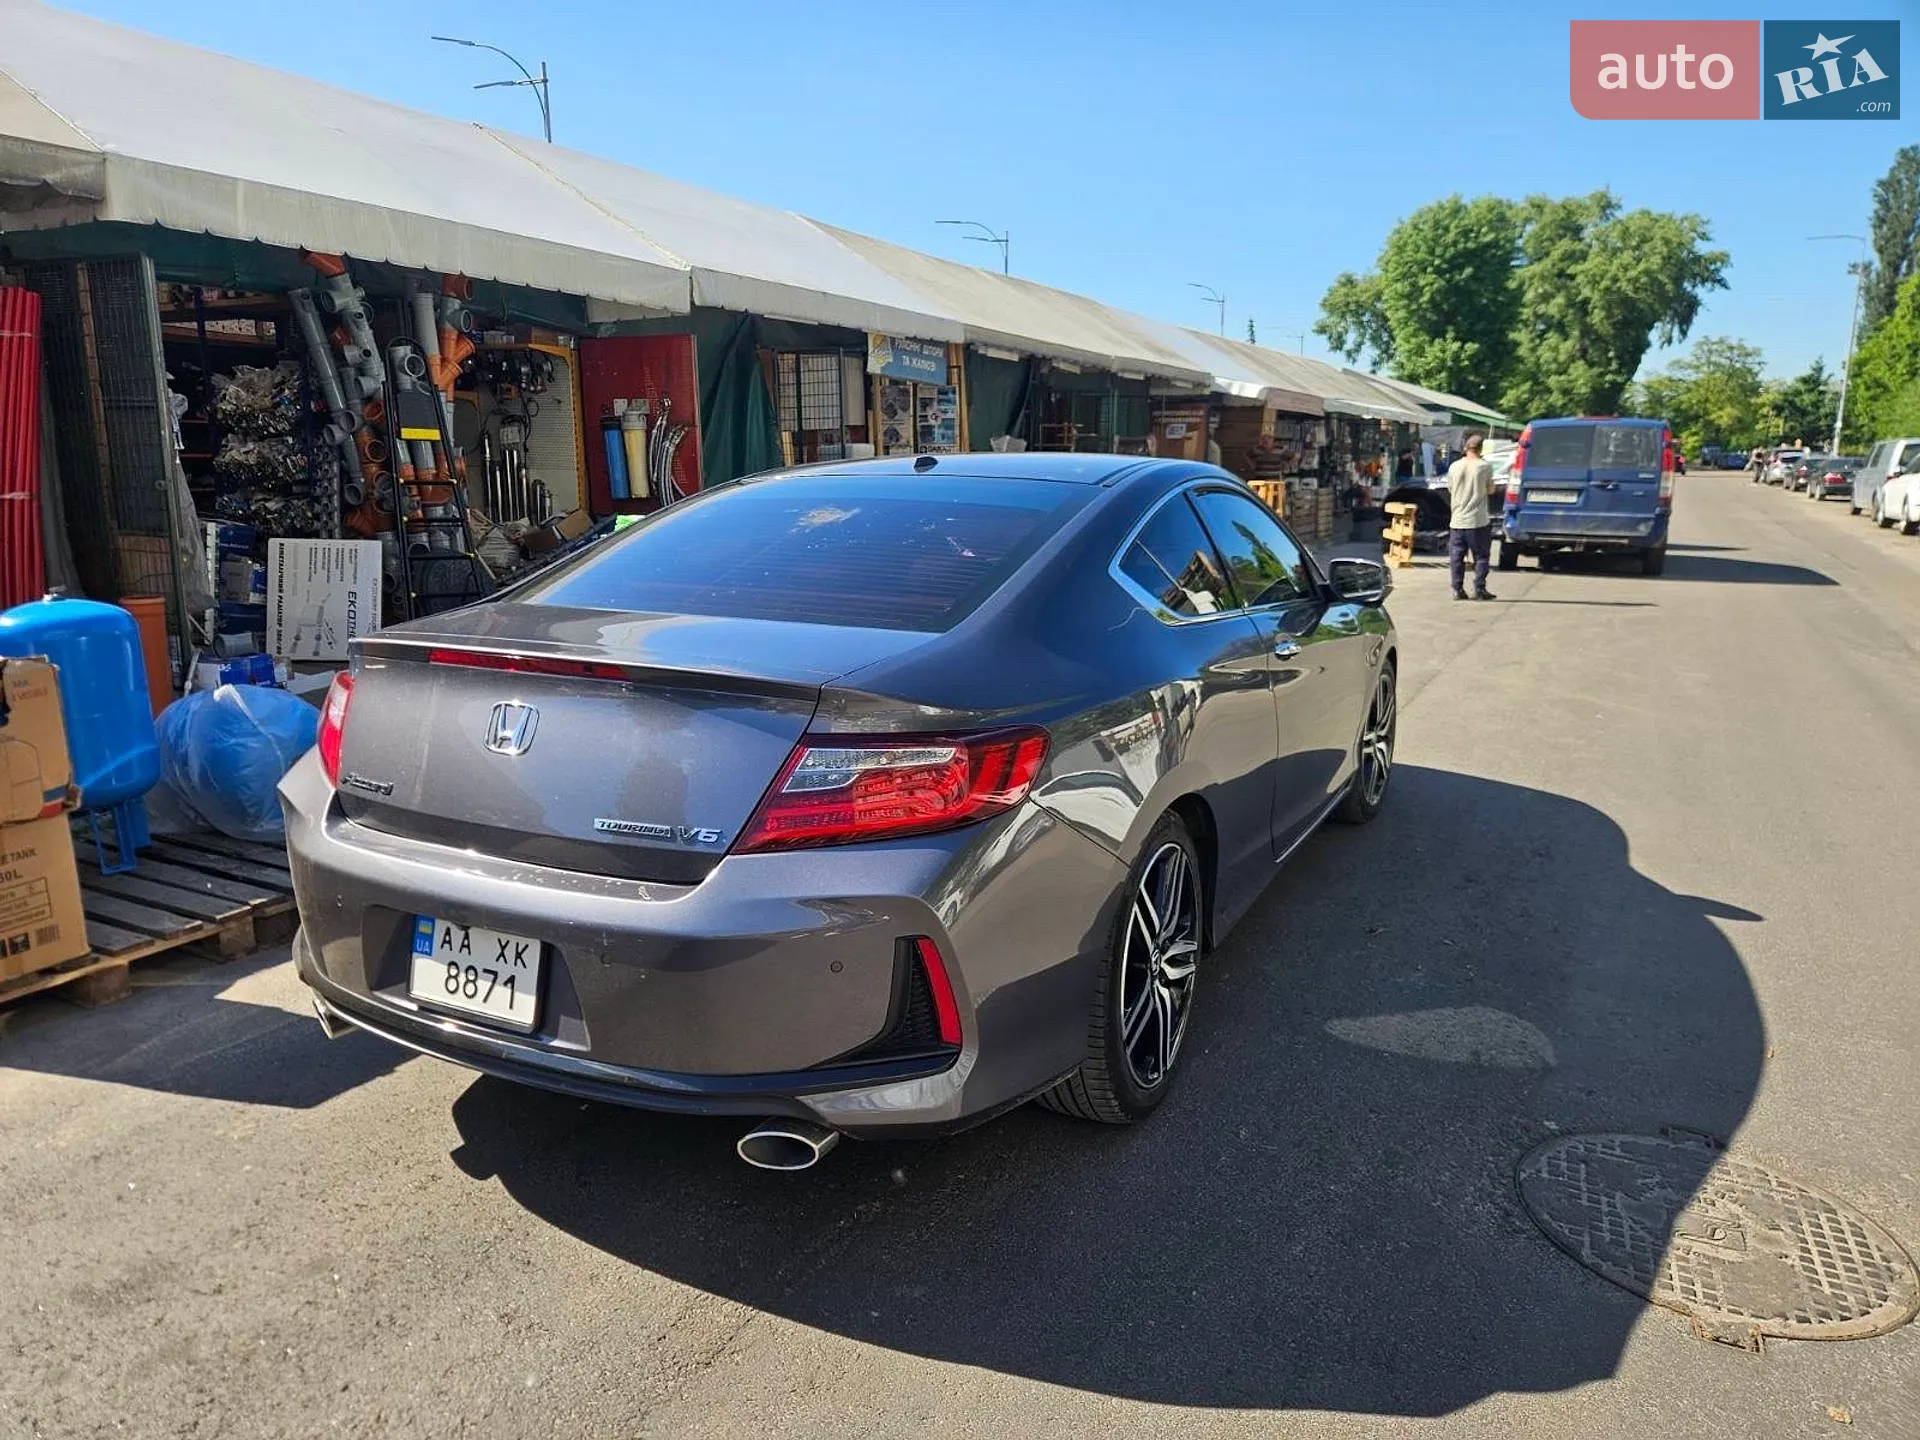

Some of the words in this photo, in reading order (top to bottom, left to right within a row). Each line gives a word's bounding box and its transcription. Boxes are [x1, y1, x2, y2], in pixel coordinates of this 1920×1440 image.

[679, 825, 723, 844] V6
[10, 847, 37, 861] TANK
[416, 938, 431, 954] UA
[495, 937, 529, 969] XK
[445, 961, 516, 1010] 8871
